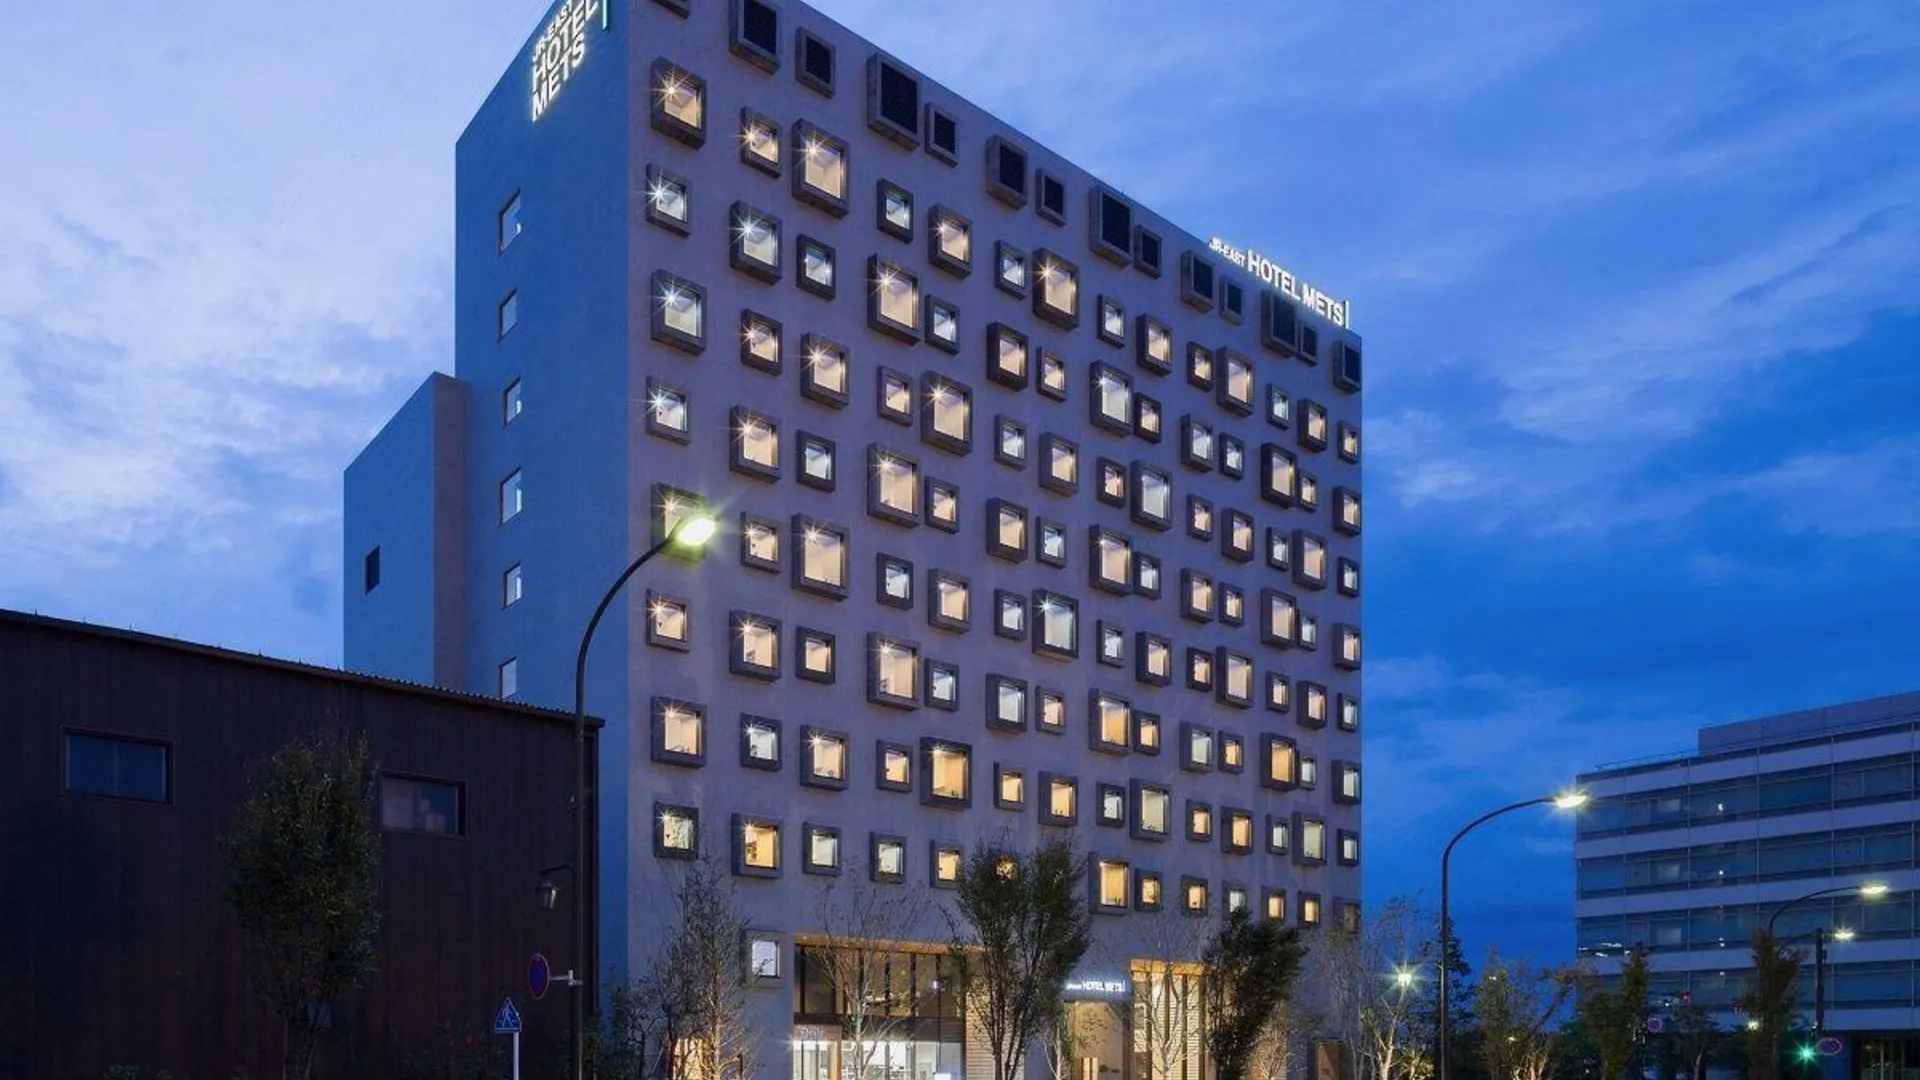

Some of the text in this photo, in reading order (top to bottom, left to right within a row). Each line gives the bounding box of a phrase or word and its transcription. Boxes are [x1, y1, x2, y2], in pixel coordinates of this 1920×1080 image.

[532, 0, 599, 93] HOTEL
[532, 32, 585, 122] METS
[1209, 237, 1344, 327] JR-EAST HOTEL METS
